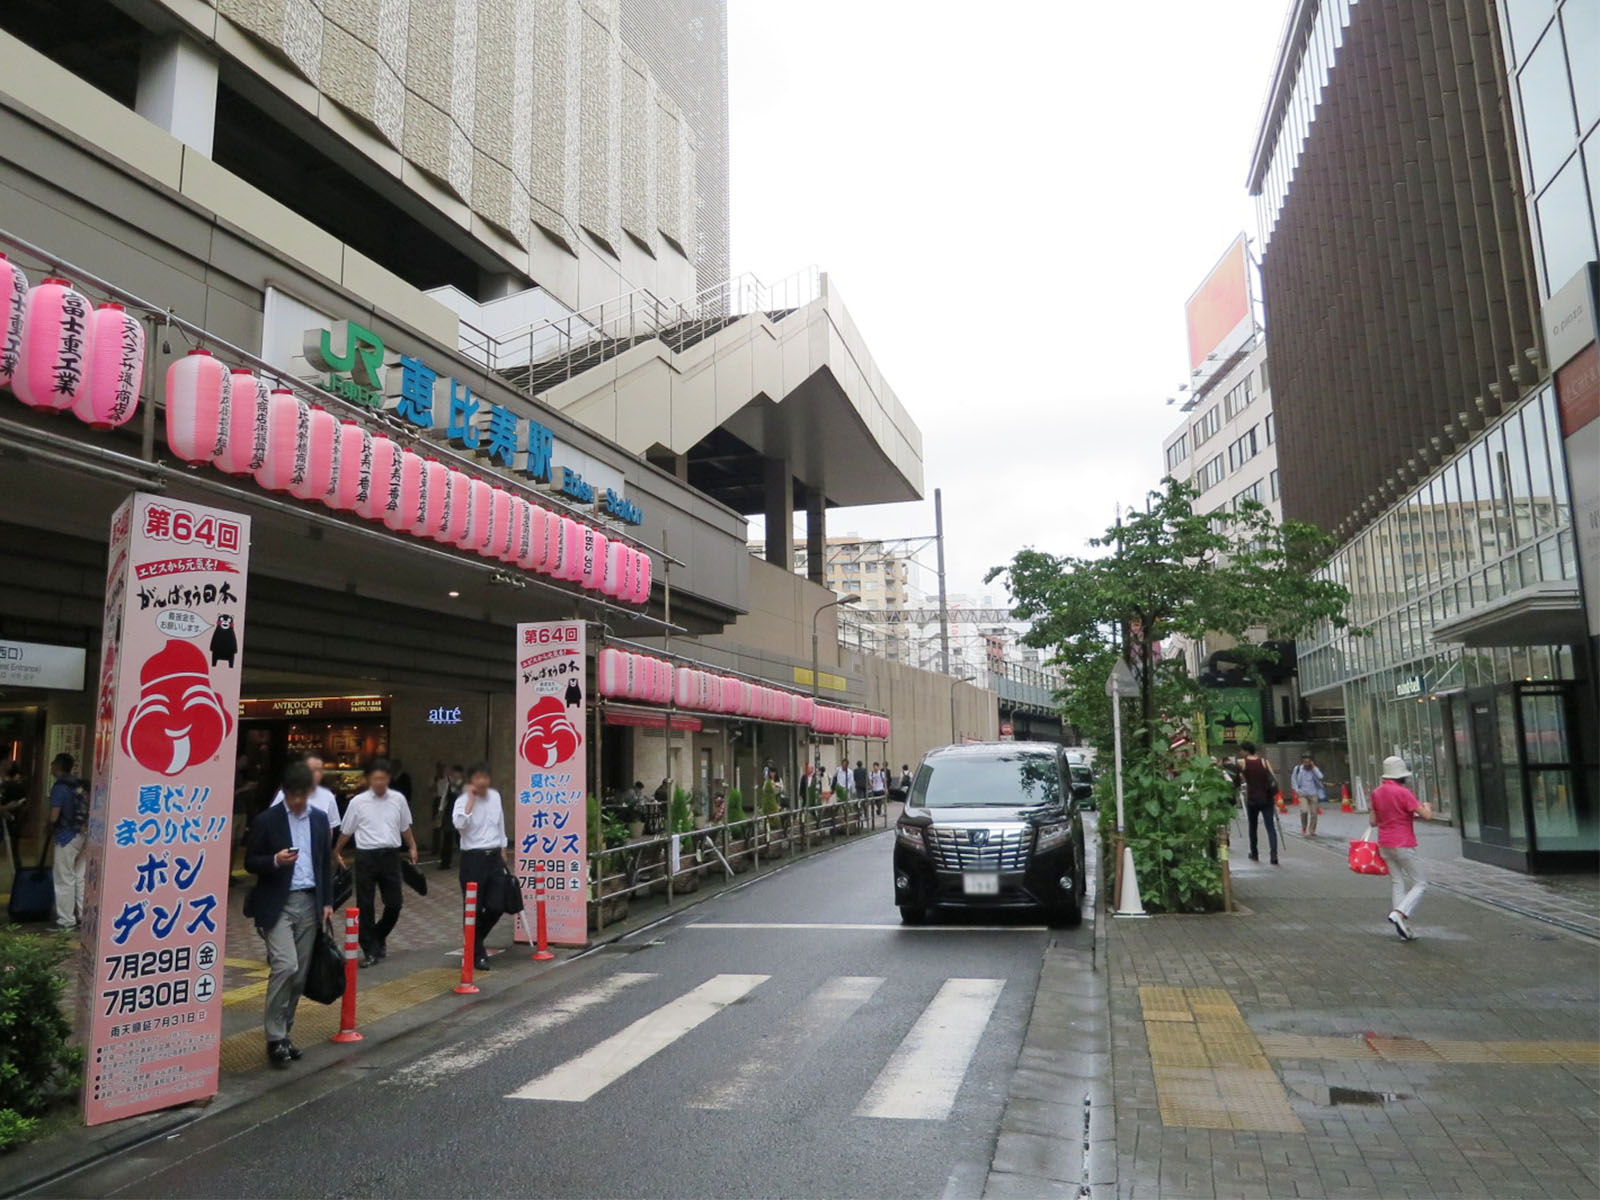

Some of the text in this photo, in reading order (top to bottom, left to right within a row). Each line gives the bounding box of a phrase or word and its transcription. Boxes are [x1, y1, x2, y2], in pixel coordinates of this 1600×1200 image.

[51, 292, 86, 397] 富士重工業
[315, 321, 385, 391] JR
[395, 354, 554, 484] 恵比寿駅
[562, 466, 642, 526] Ebisu Station
[144, 505, 240, 552] 第64回
[583, 530, 594, 575] EBIS 303
[136, 580, 238, 610] がんばろう日本
[523, 627, 578, 644] 第64回
[272, 701, 300, 710] ANTICO
[428, 706, 461, 721] atré
[137, 785, 210, 815] 夏だ!!
[114, 816, 227, 846] まつりだ!!
[135, 850, 205, 893] ボン
[519, 876, 565, 890] 7月0日
[112, 894, 217, 945] ダンス
[105, 947, 191, 982] 7月29日
[102, 976, 214, 1016] 7月30日 土
[110, 1012, 196, 1037] 雨天順延7月31日
